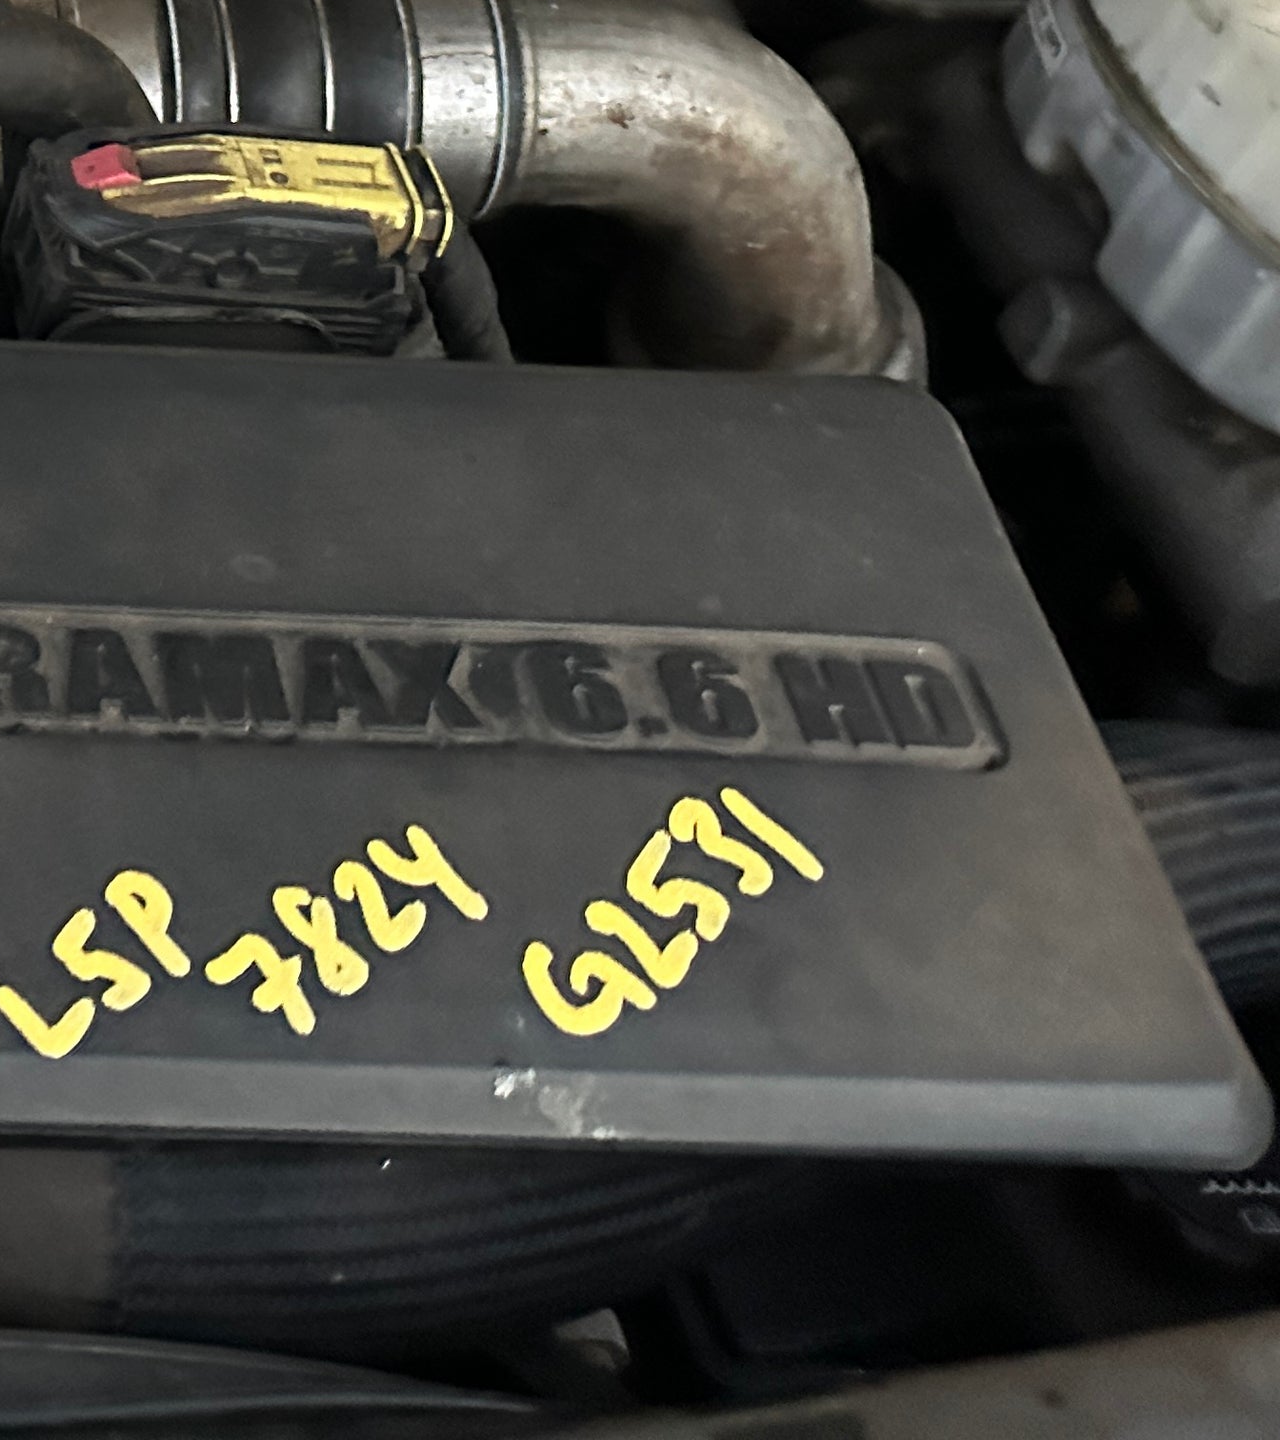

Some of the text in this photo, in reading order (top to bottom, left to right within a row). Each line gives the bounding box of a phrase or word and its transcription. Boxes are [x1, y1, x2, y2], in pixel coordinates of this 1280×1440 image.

[528, 640, 762, 739] 6.6
[772, 654, 978, 751] HD
[203, 823, 486, 1035] 7824
[520, 786, 823, 1038] G2531
